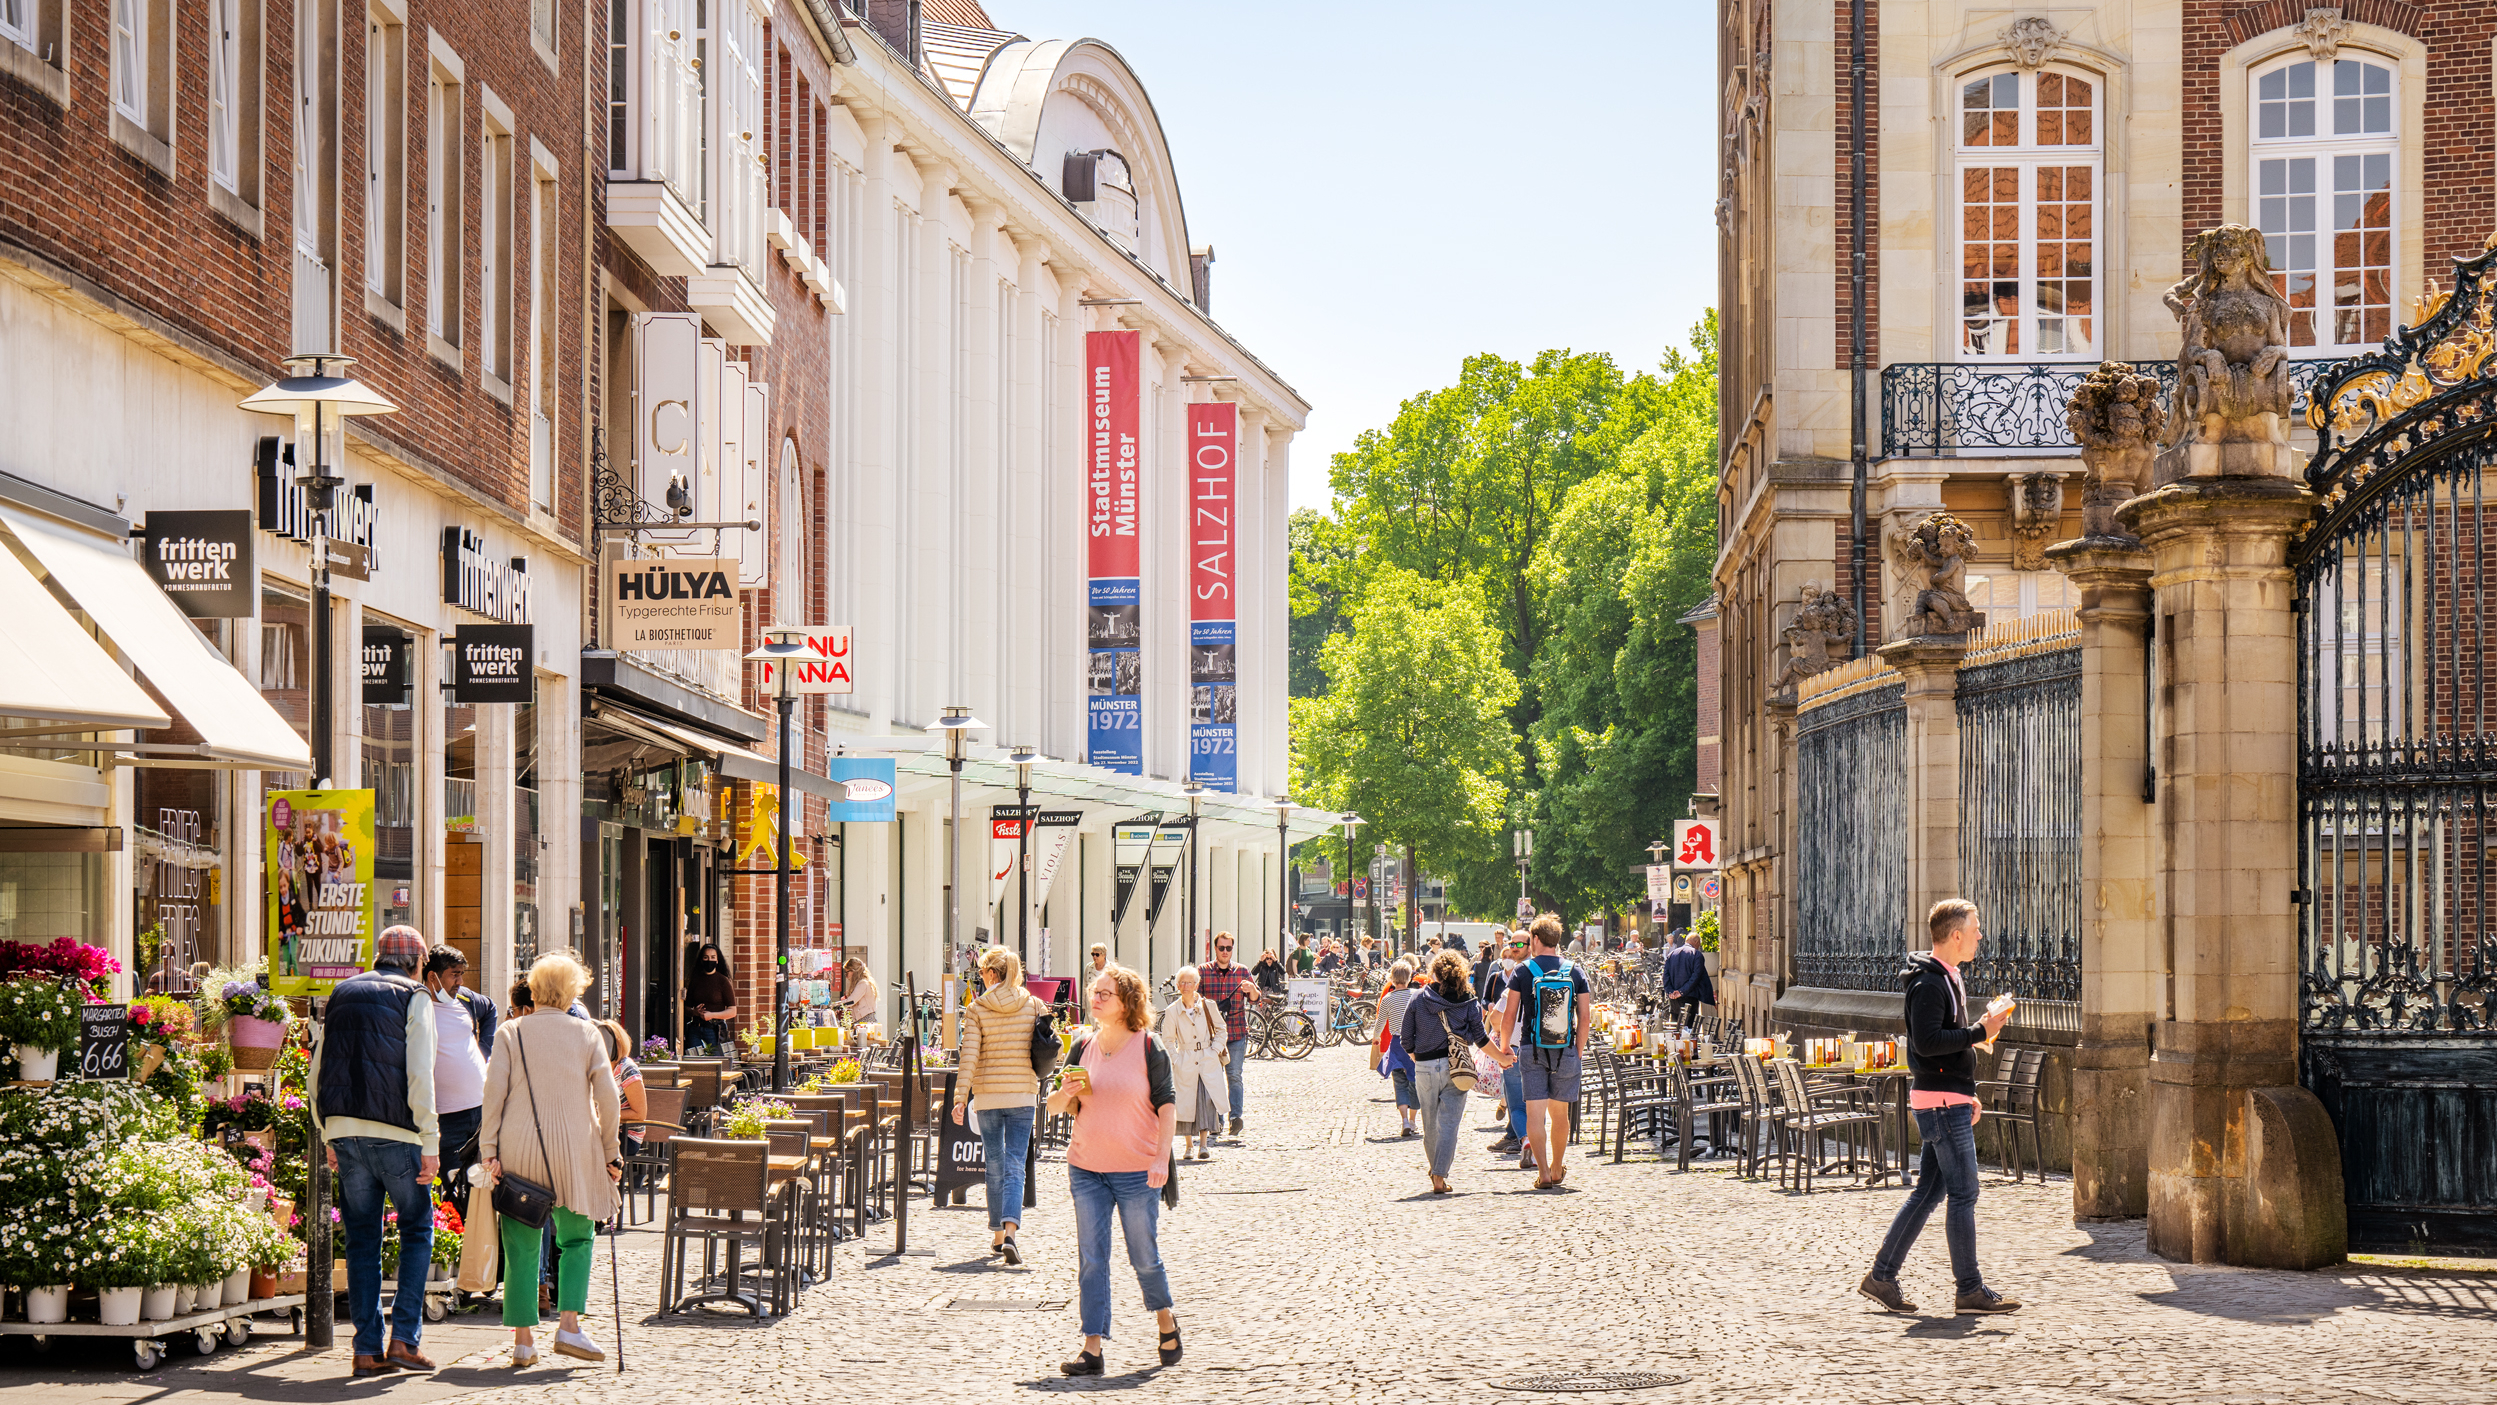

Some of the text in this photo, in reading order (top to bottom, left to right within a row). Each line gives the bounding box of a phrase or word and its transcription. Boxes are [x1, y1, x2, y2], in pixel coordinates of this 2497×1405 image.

[1091, 366, 1110, 537] Stadtmuseum
[1114, 433, 1135, 536] Münster
[1196, 421, 1228, 600] SALZHOF
[158, 537, 237, 561] fritten
[165, 555, 231, 580] werk
[163, 583, 232, 592] POMMESMANUFAKTUR
[618, 566, 733, 600] HÜLYA
[1110, 586, 1136, 595] Jahren
[618, 604, 734, 620] Typgerechte Frisur
[635, 630, 646, 641] LA
[465, 644, 523, 661] fritten
[470, 656, 518, 676] werk
[1090, 699, 1138, 710] MÜNSTER
[1089, 711, 1139, 730] 1972
[1192, 727, 1234, 737] MÜNSTER
[1191, 738, 1235, 755] 1972
[996, 809, 1033, 817] SALZHF
[995, 823, 1020, 836] Fissle
[159, 807, 201, 900] FRIES
[318, 883, 367, 907] ERSTE
[304, 911, 366, 935] STUNDE:
[298, 939, 366, 963] ZUKUNFT.
[88, 1025, 119, 1038] BUSCH
[84, 1042, 122, 1077] 6,66
